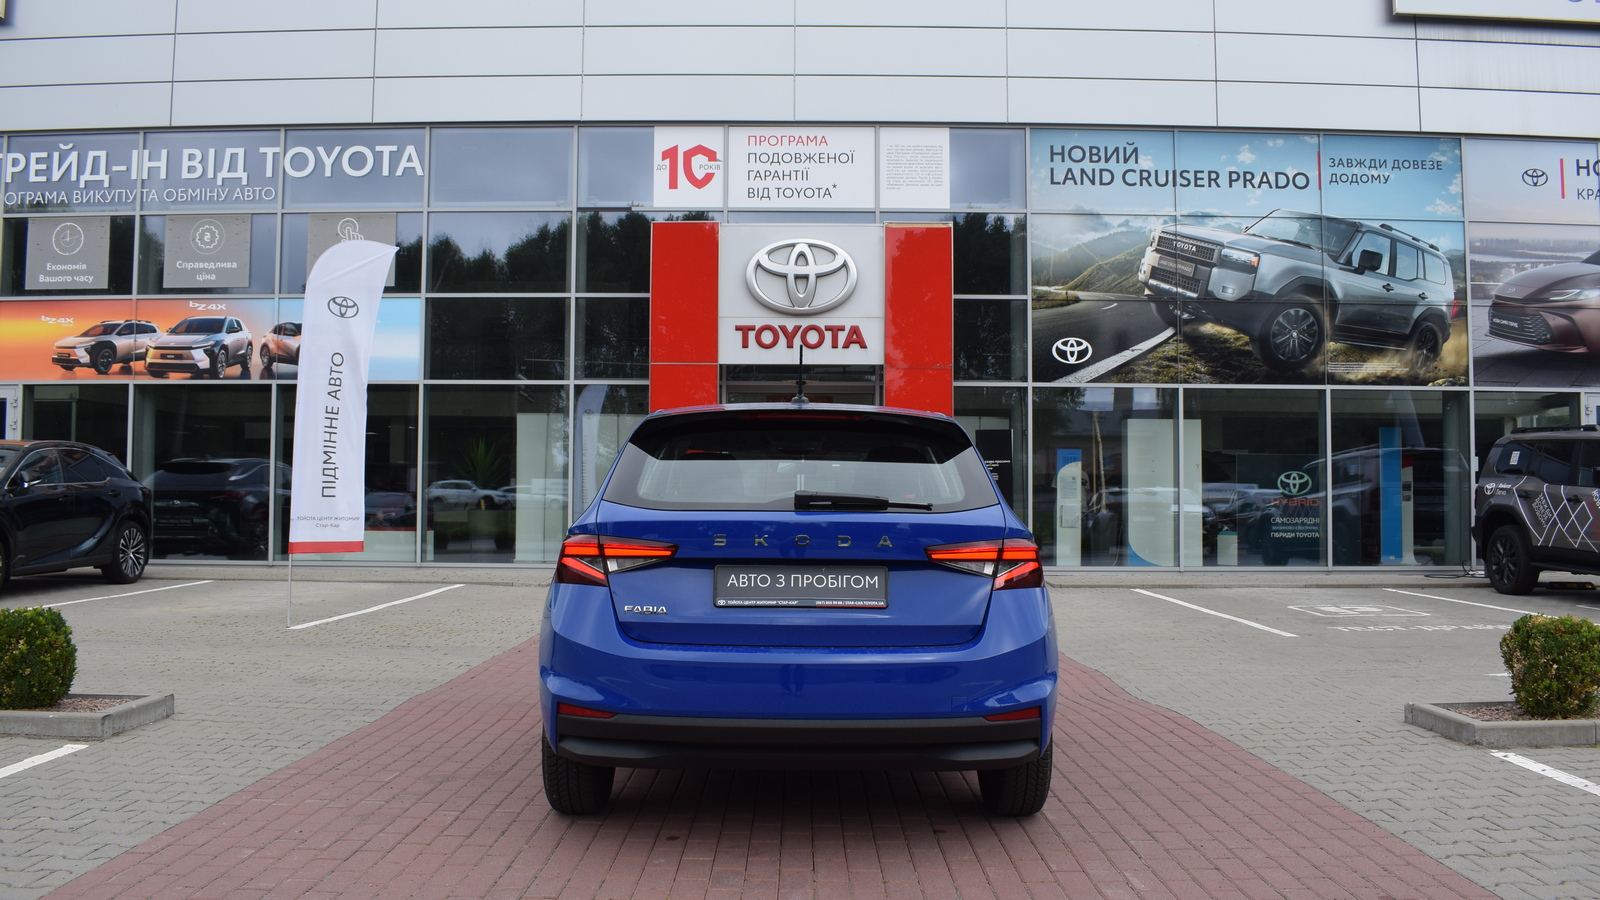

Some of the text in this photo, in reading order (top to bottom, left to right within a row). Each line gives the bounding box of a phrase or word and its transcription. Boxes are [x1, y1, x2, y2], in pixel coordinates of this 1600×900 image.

[747, 135, 828, 147] ПРОГРАМА
[747, 150, 855, 166] ПОДОВЖЕНОЇ
[1049, 141, 1139, 165] НОВИЙ
[181, 148, 248, 186] ВІД
[259, 145, 424, 178] TOYOTA
[1328, 157, 1443, 172] ЗАВЖДИ ДОВЕЗЕ
[747, 167, 810, 181] ГАРАНТІЇ
[1050, 167, 1310, 190] LAND CRUISER PRADO
[1328, 173, 1391, 186] ДОДОМУ
[73, 188, 137, 204] ВИКУПУ
[142, 188, 159, 203] ТА
[163, 186, 229, 202] ОБМІНУ
[233, 186, 276, 201] АВТО
[747, 187, 771, 201] ВІД
[1173, 240, 1196, 252] TOYOTA
[46, 262, 87, 271] Економія
[176, 260, 238, 270] Справедлива
[39, 274, 94, 284] Вашого часу
[196, 273, 216, 281] ціна
[189, 300, 227, 311] bZ4X
[735, 324, 868, 349] TOYOTA
[321, 352, 345, 498] ПІДМІННЕ АВТО
[1270, 498, 1320, 506] HYBRID
[713, 533, 893, 547] SKODA
[727, 574, 771, 588] АВТО
[790, 574, 879, 589] ПРОБІГОМ
[624, 605, 668, 615] FABIA
